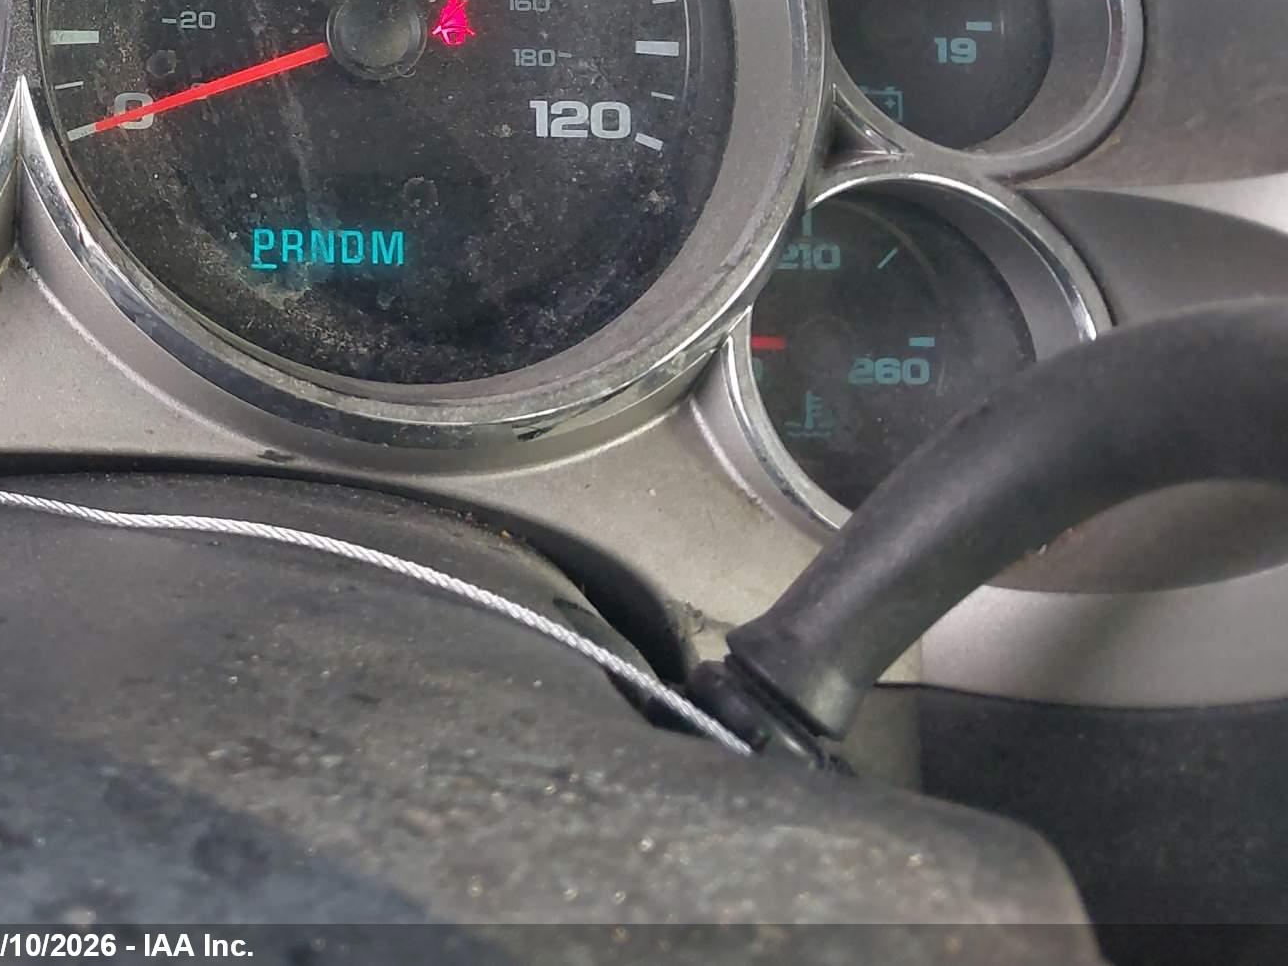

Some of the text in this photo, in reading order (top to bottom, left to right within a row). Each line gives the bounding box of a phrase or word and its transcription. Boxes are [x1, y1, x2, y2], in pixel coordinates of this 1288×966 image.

[178, 11, 217, 30] 20
[513, 48, 556, 68] 180
[934, 37, 977, 63] 19
[114, 92, 154, 129] 0
[529, 100, 631, 139] 120
[251, 228, 405, 269] PRNDM
[776, 242, 841, 270] 210
[848, 358, 930, 385] 260
